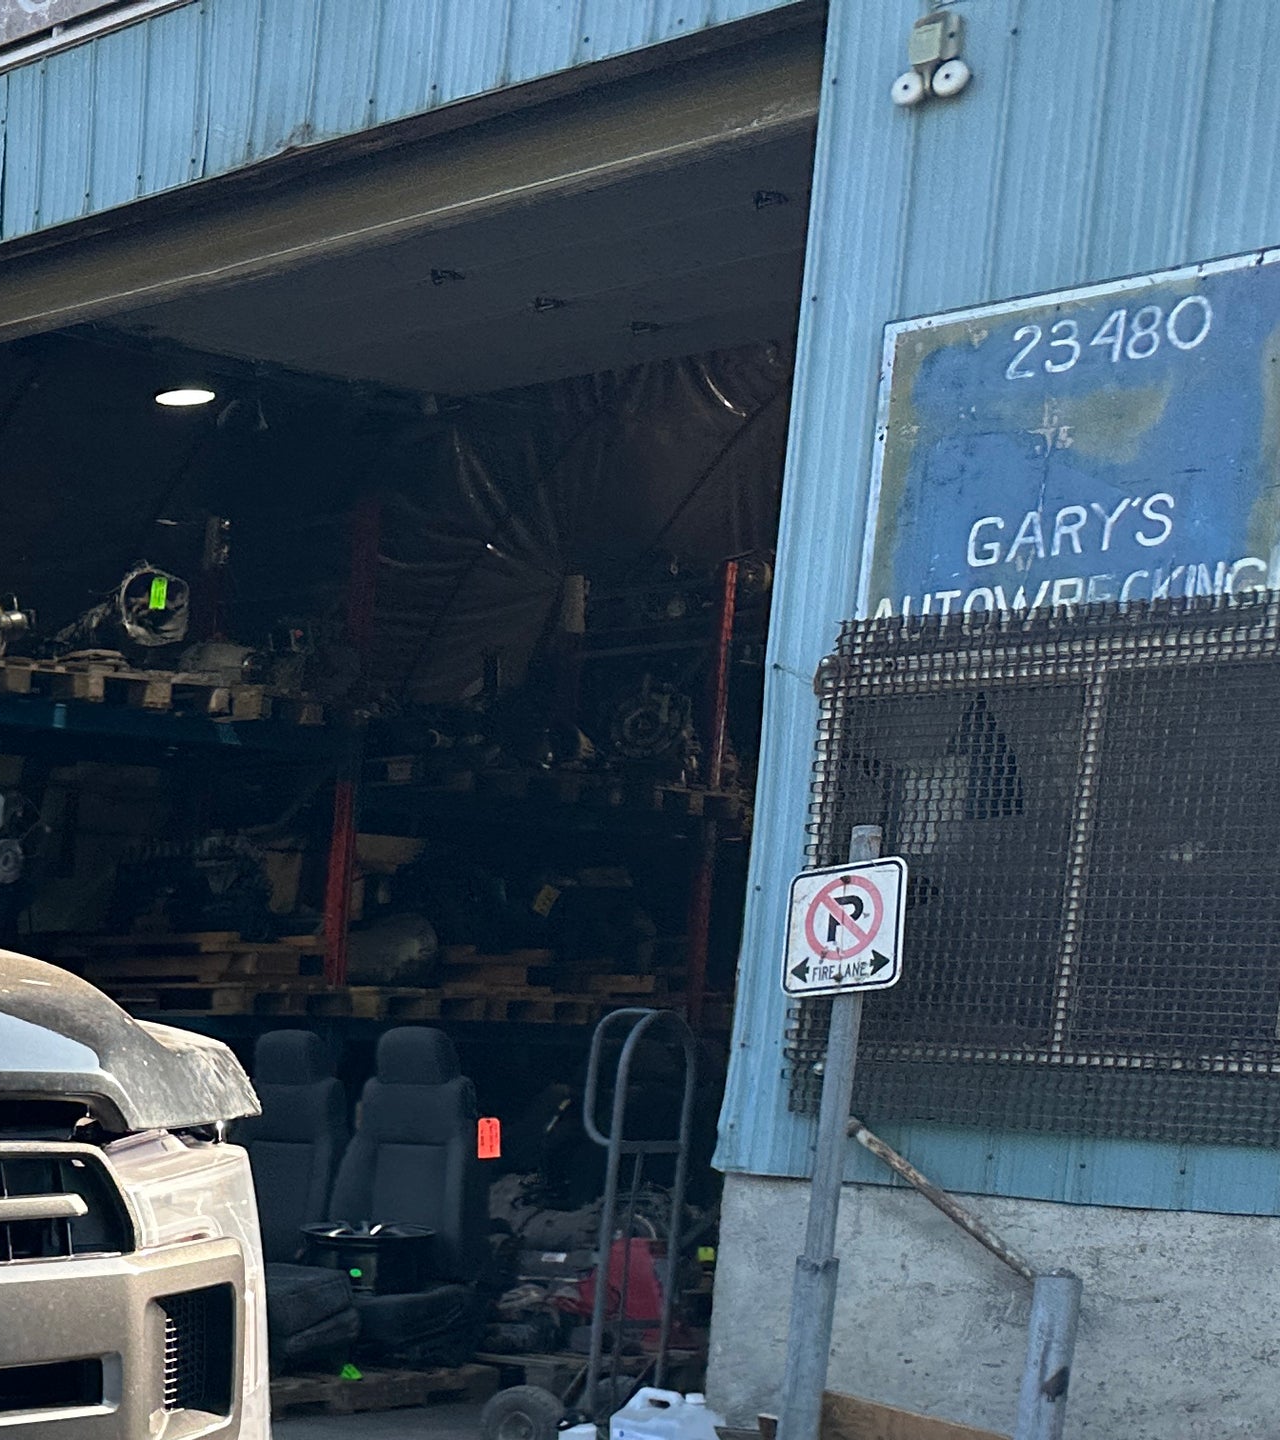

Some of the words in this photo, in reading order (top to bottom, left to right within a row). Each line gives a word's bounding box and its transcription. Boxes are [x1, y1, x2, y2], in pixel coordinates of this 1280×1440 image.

[1005, 295, 1213, 380] 23480
[966, 493, 1175, 568] GARY'S
[811, 964, 836, 982] FIRE
